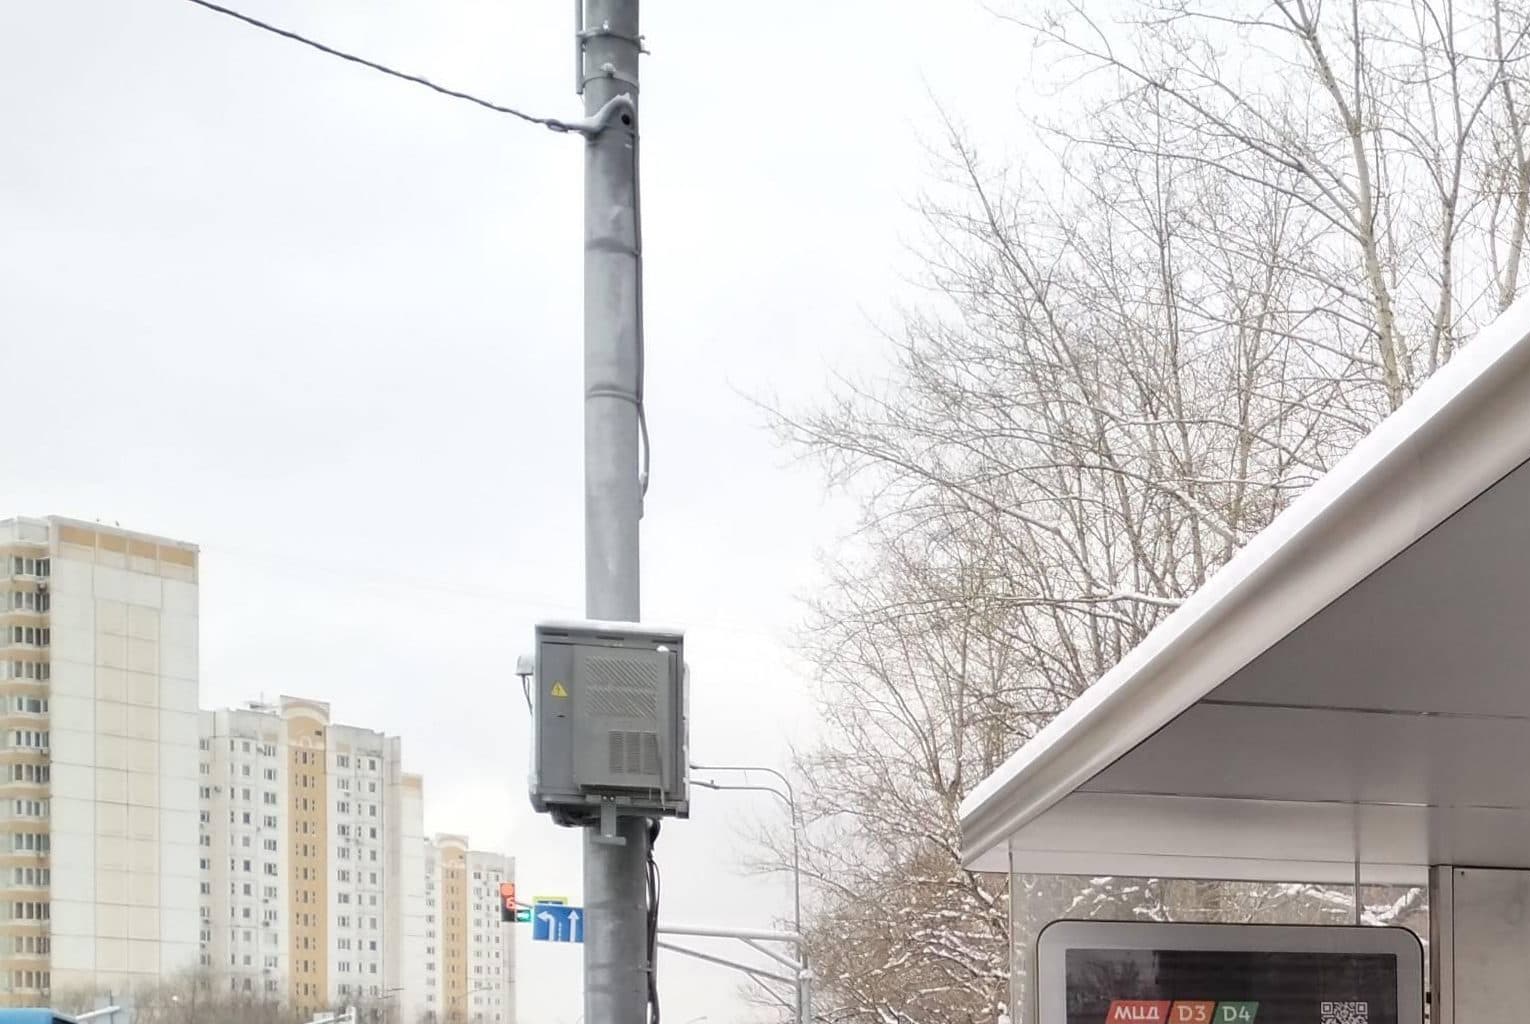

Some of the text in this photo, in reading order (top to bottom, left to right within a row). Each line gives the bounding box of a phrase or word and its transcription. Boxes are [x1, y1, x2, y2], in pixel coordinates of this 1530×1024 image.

[1114, 1006, 1250, 1021] МЦД D3 D4
